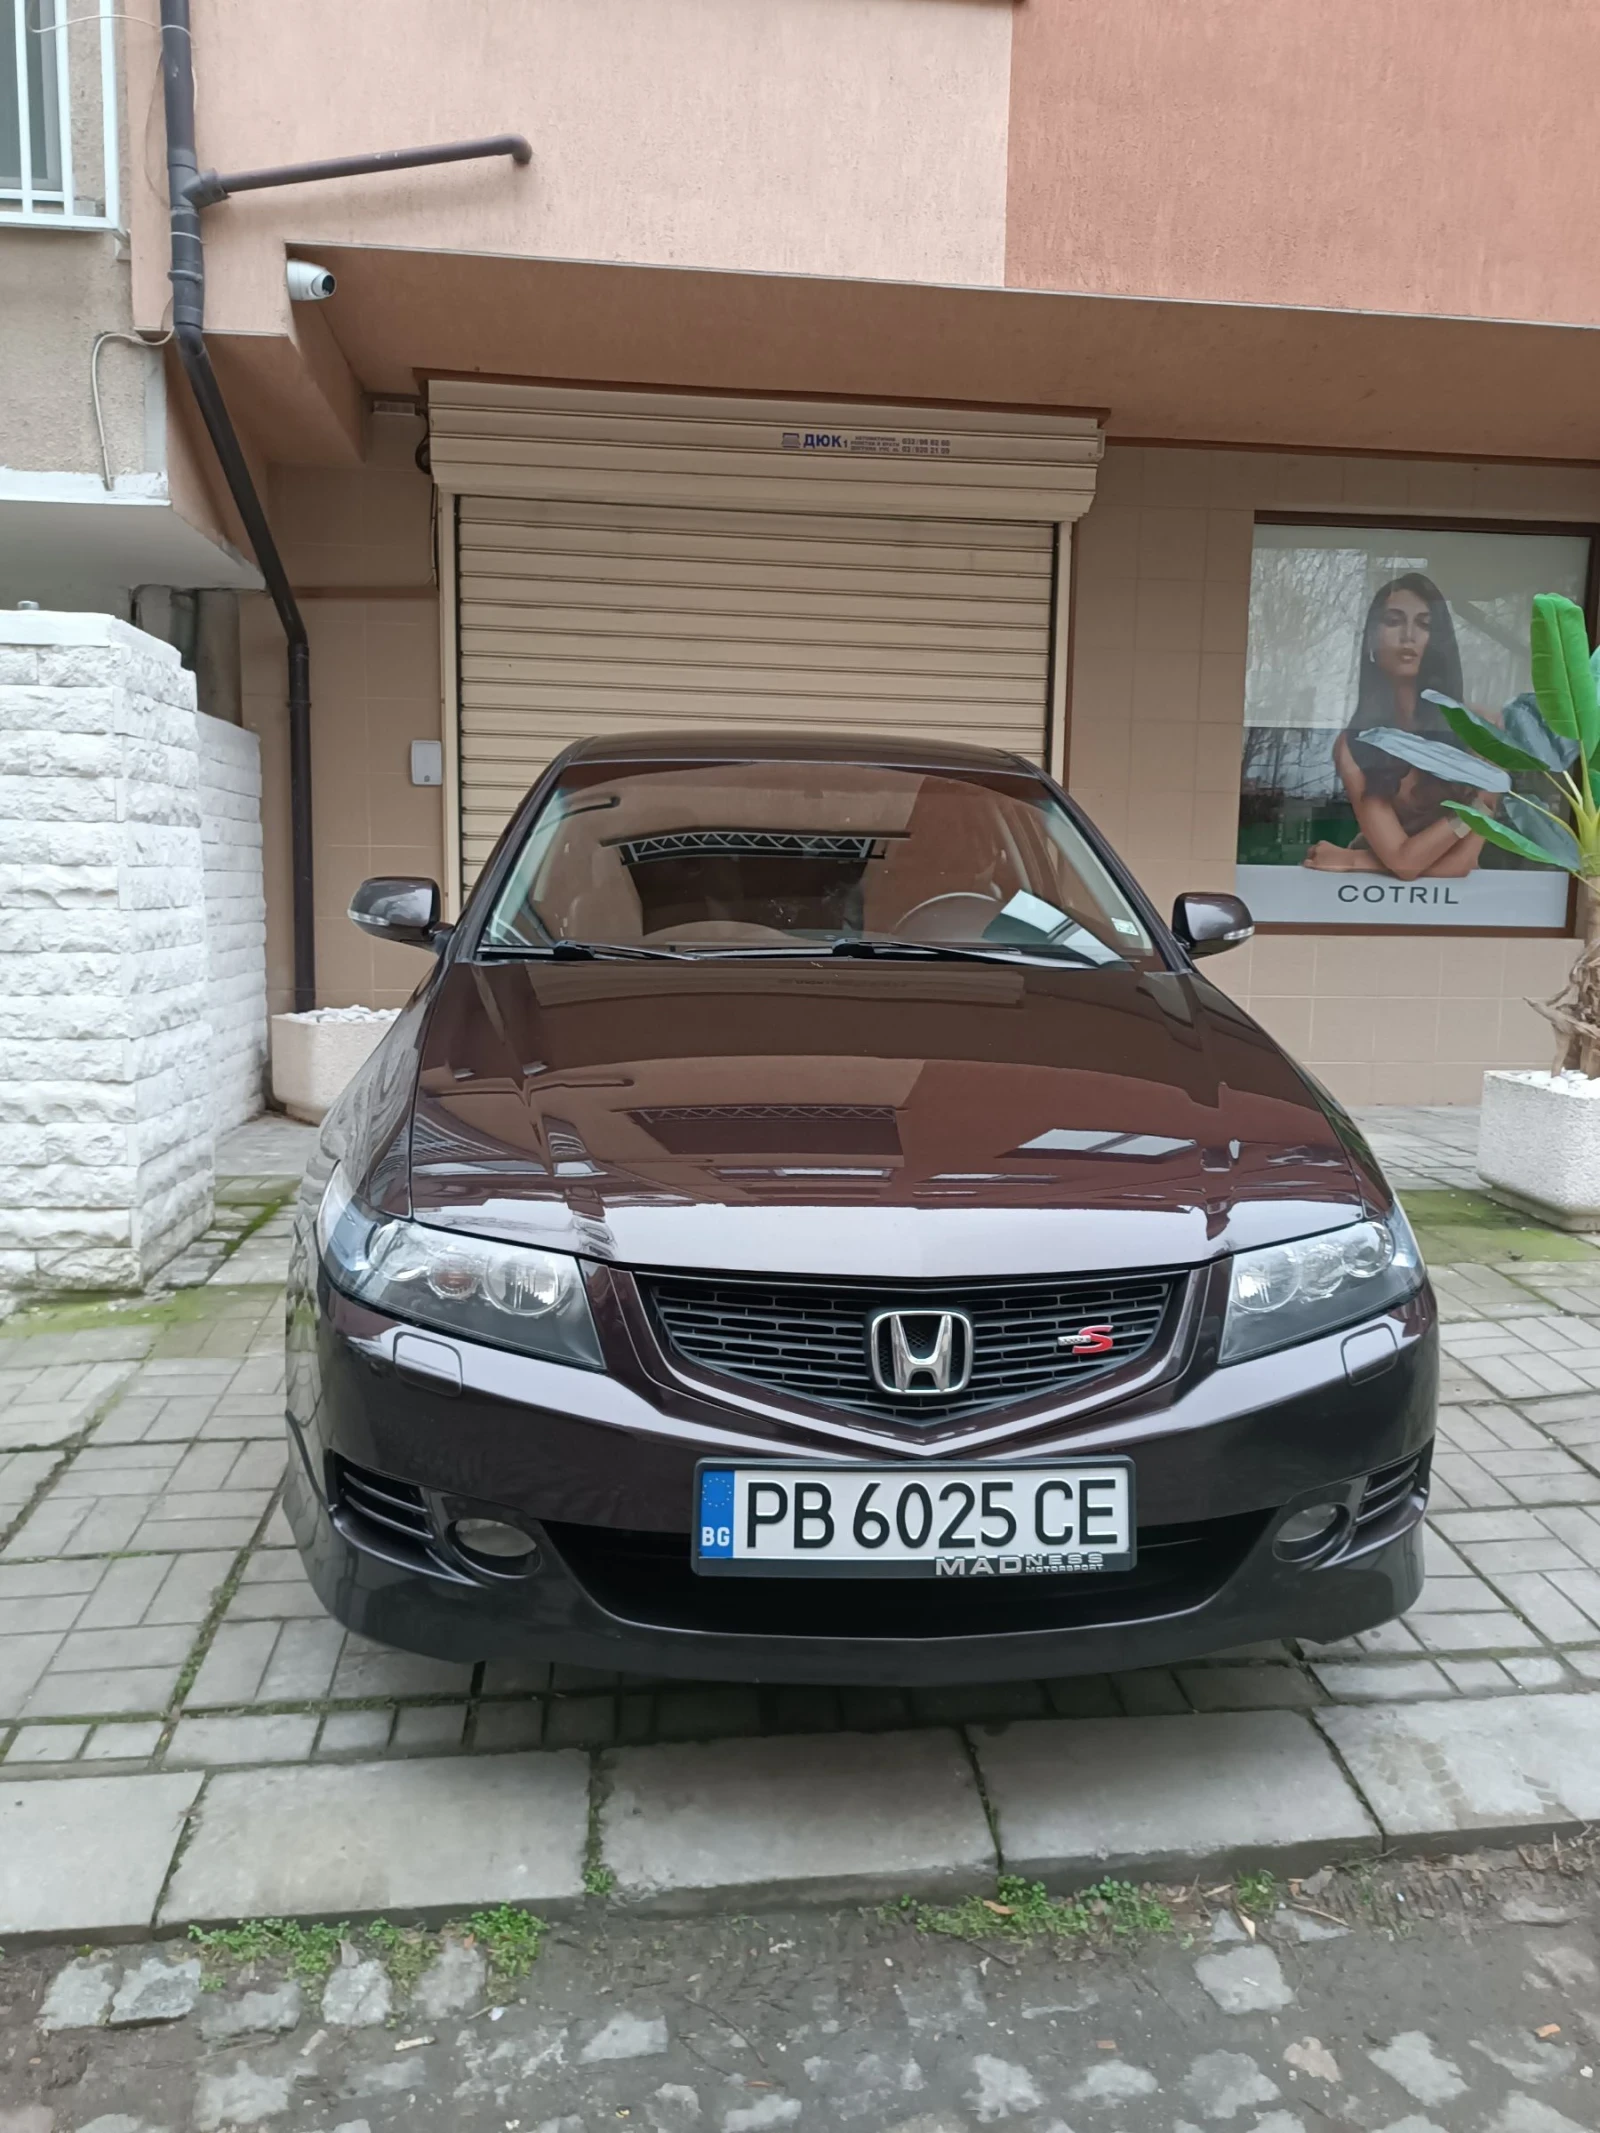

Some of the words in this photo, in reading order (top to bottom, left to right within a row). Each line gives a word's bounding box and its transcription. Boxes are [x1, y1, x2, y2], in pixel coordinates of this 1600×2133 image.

[803, 433, 842, 449] ДЮК
[1337, 884, 1460, 905] COTRIL
[746, 1480, 835, 1549] PB
[852, 1480, 1018, 1549] 6025
[1034, 1477, 1119, 1546] CE
[701, 1526, 731, 1547] BG
[1025, 1564, 1105, 1574] MOTORSPORT
